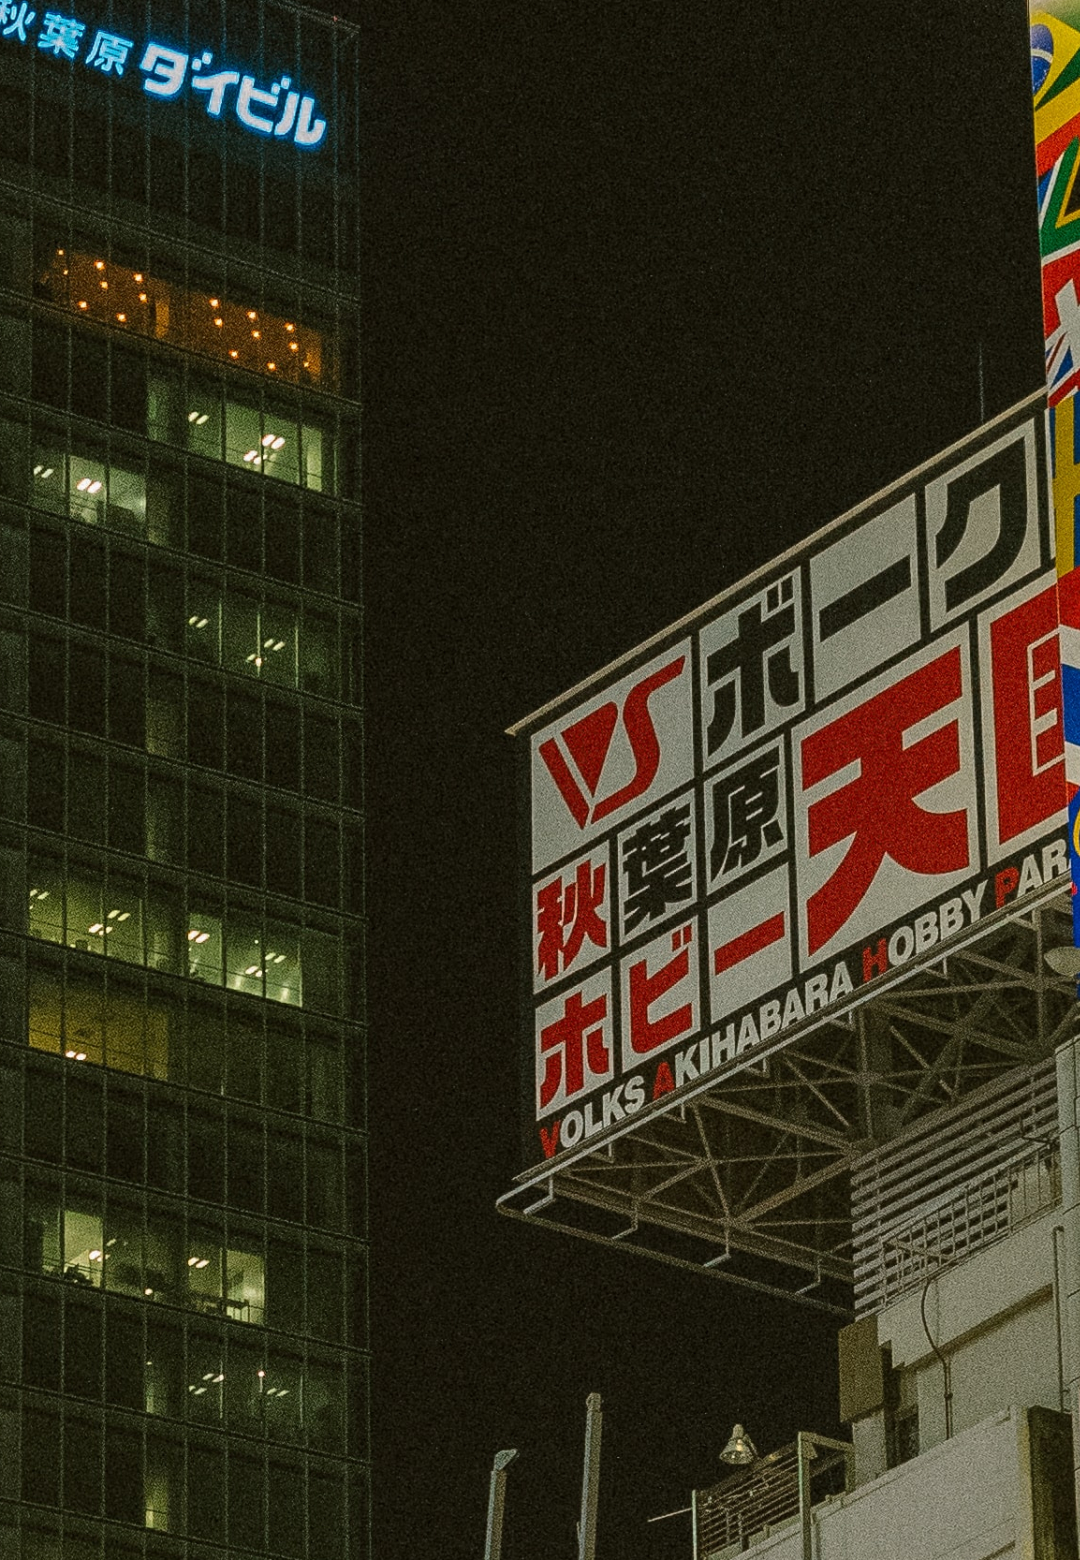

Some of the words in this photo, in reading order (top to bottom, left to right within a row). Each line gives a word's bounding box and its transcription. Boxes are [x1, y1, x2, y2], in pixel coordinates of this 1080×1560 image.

[533, 757, 785, 983] 秋葉原
[538, 1074, 645, 1160] VOLKS
[652, 960, 854, 1095] AKIHABARA
[861, 880, 988, 984] HOBBY
[995, 838, 1069, 909] PAR
[540, 912, 786, 1108] ホビー
